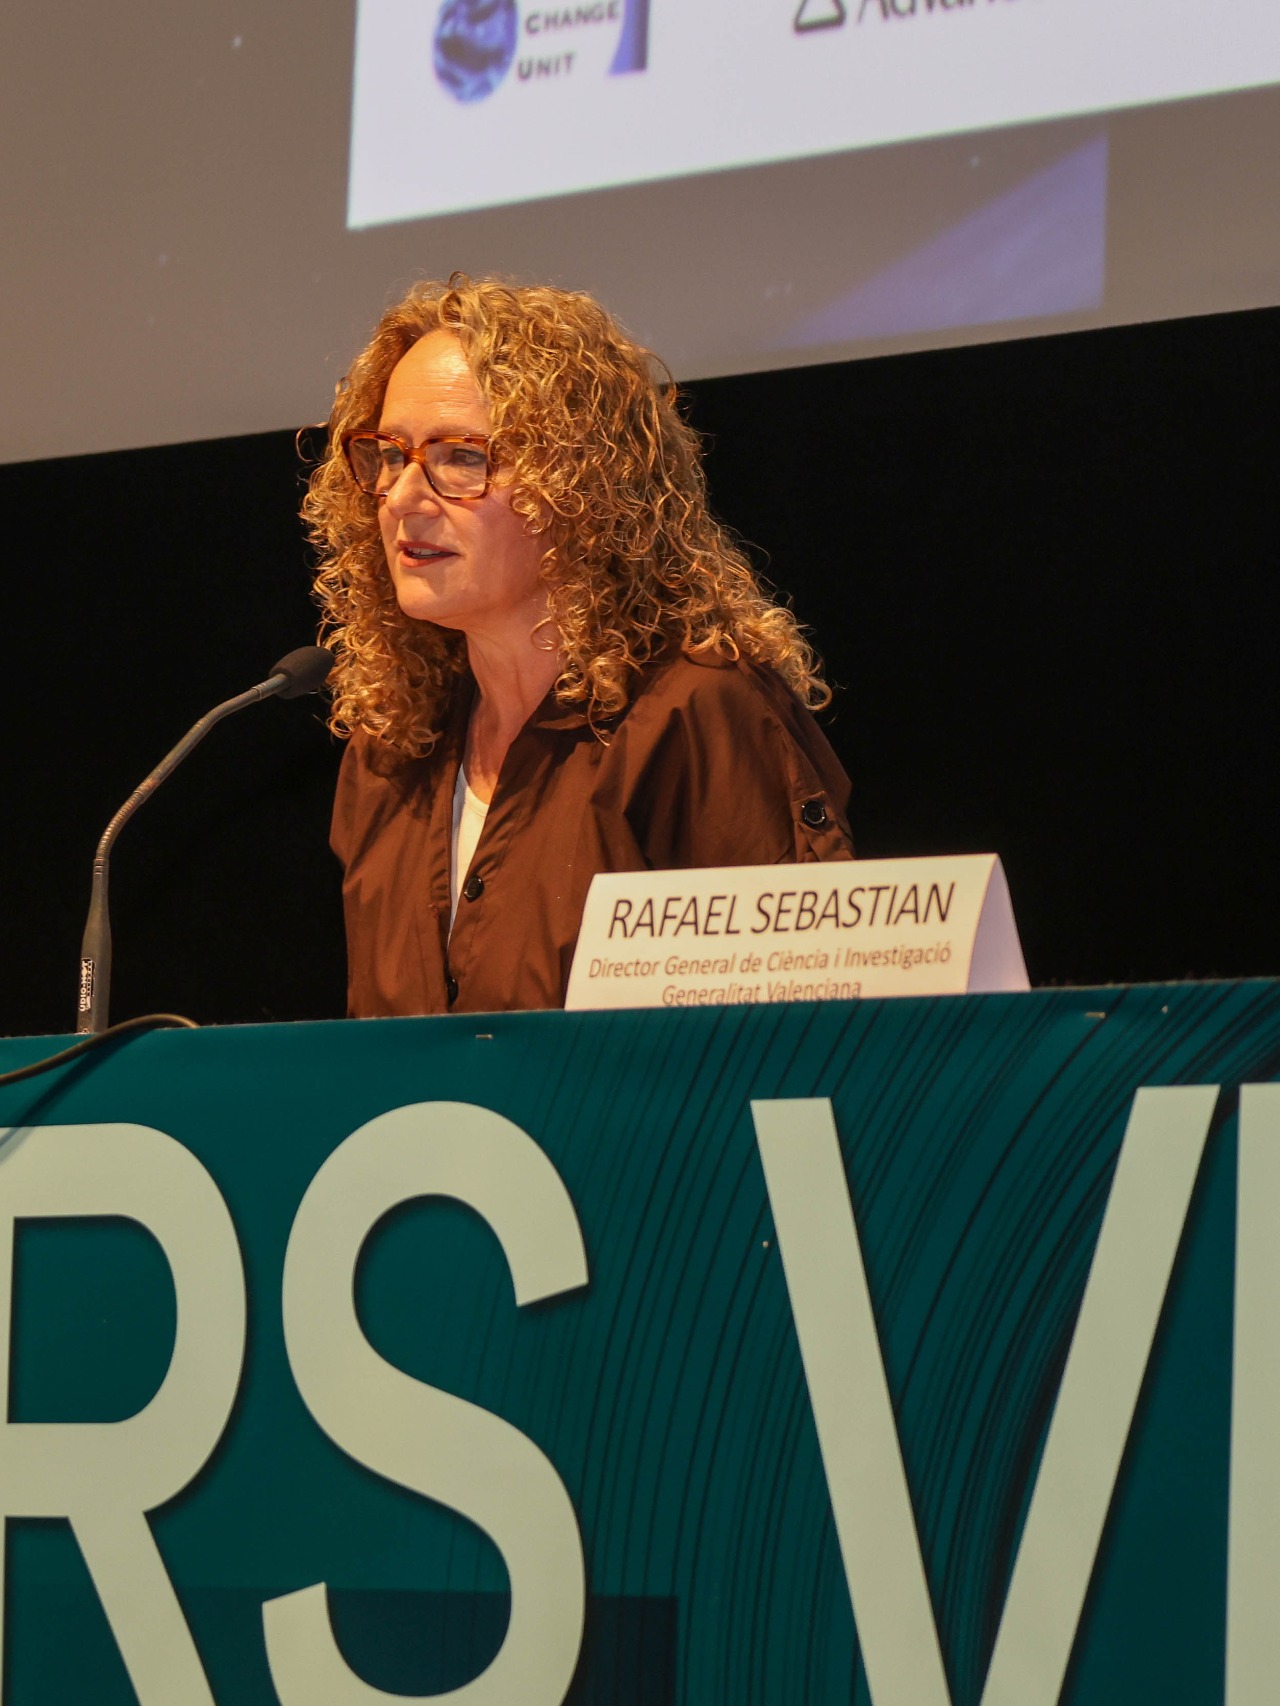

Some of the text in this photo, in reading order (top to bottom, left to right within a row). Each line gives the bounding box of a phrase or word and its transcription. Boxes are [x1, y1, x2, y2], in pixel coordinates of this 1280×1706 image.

[525, 0, 619, 34] CHANGE
[517, 53, 575, 81] UNIT
[608, 882, 956, 939] RAFAEL SEBASTIAN
[588, 941, 952, 978] Director General de Ciència i Investigació
[661, 979, 862, 1006] Generalitat Valenciana
